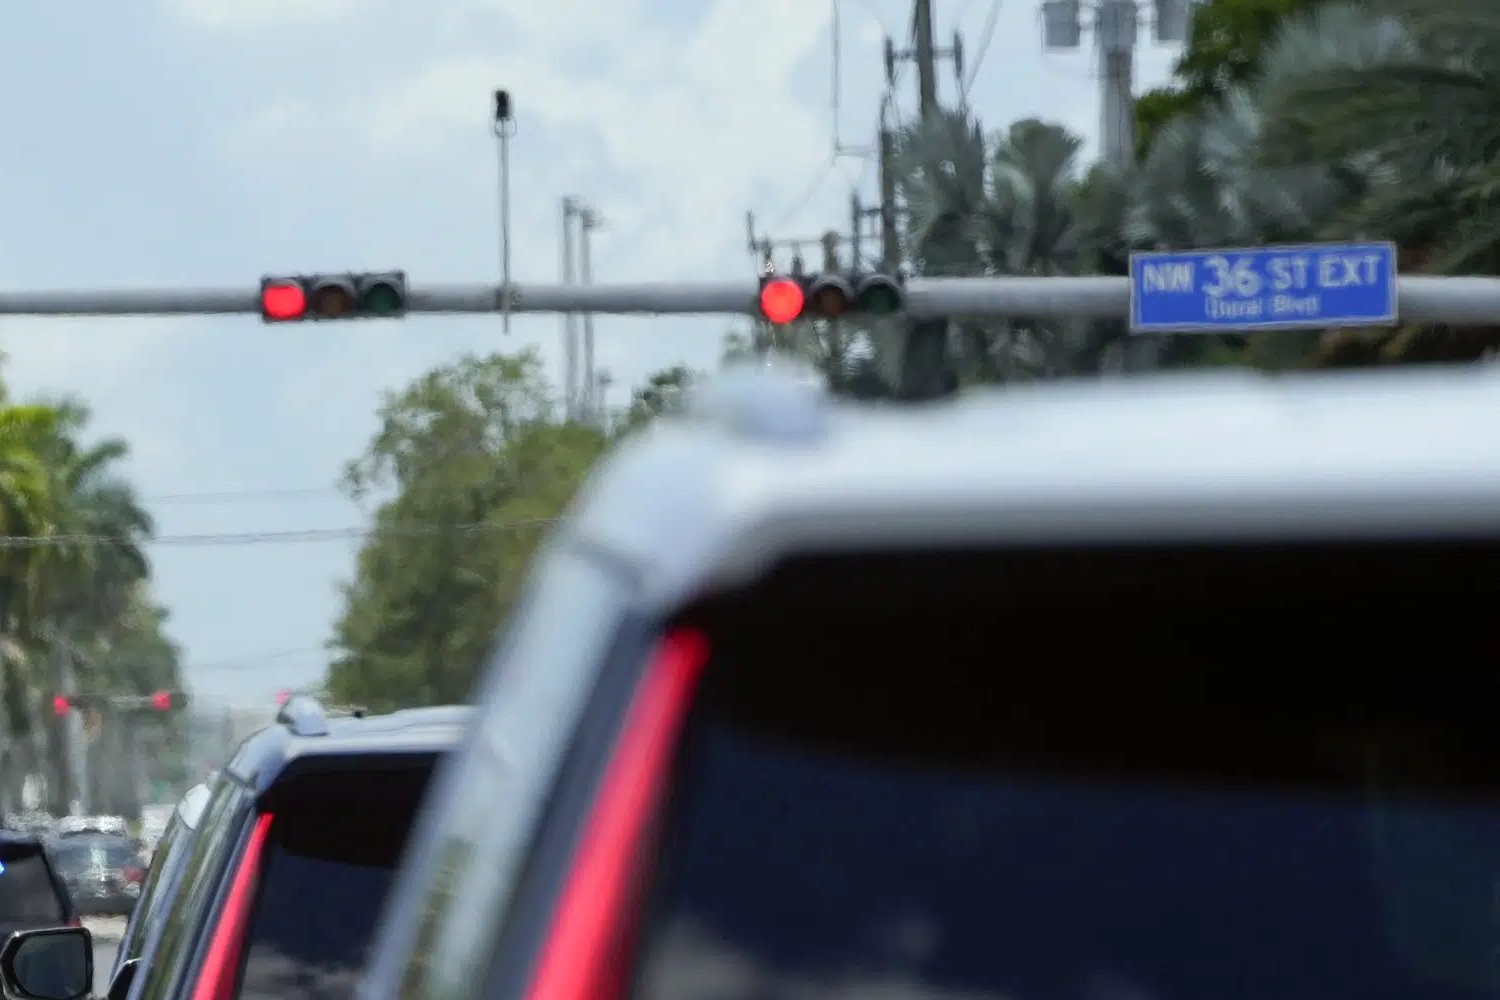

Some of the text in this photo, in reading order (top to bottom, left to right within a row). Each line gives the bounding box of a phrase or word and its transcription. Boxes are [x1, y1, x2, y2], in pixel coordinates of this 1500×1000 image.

[1143, 254, 1381, 298] NW 36 ST EXT
